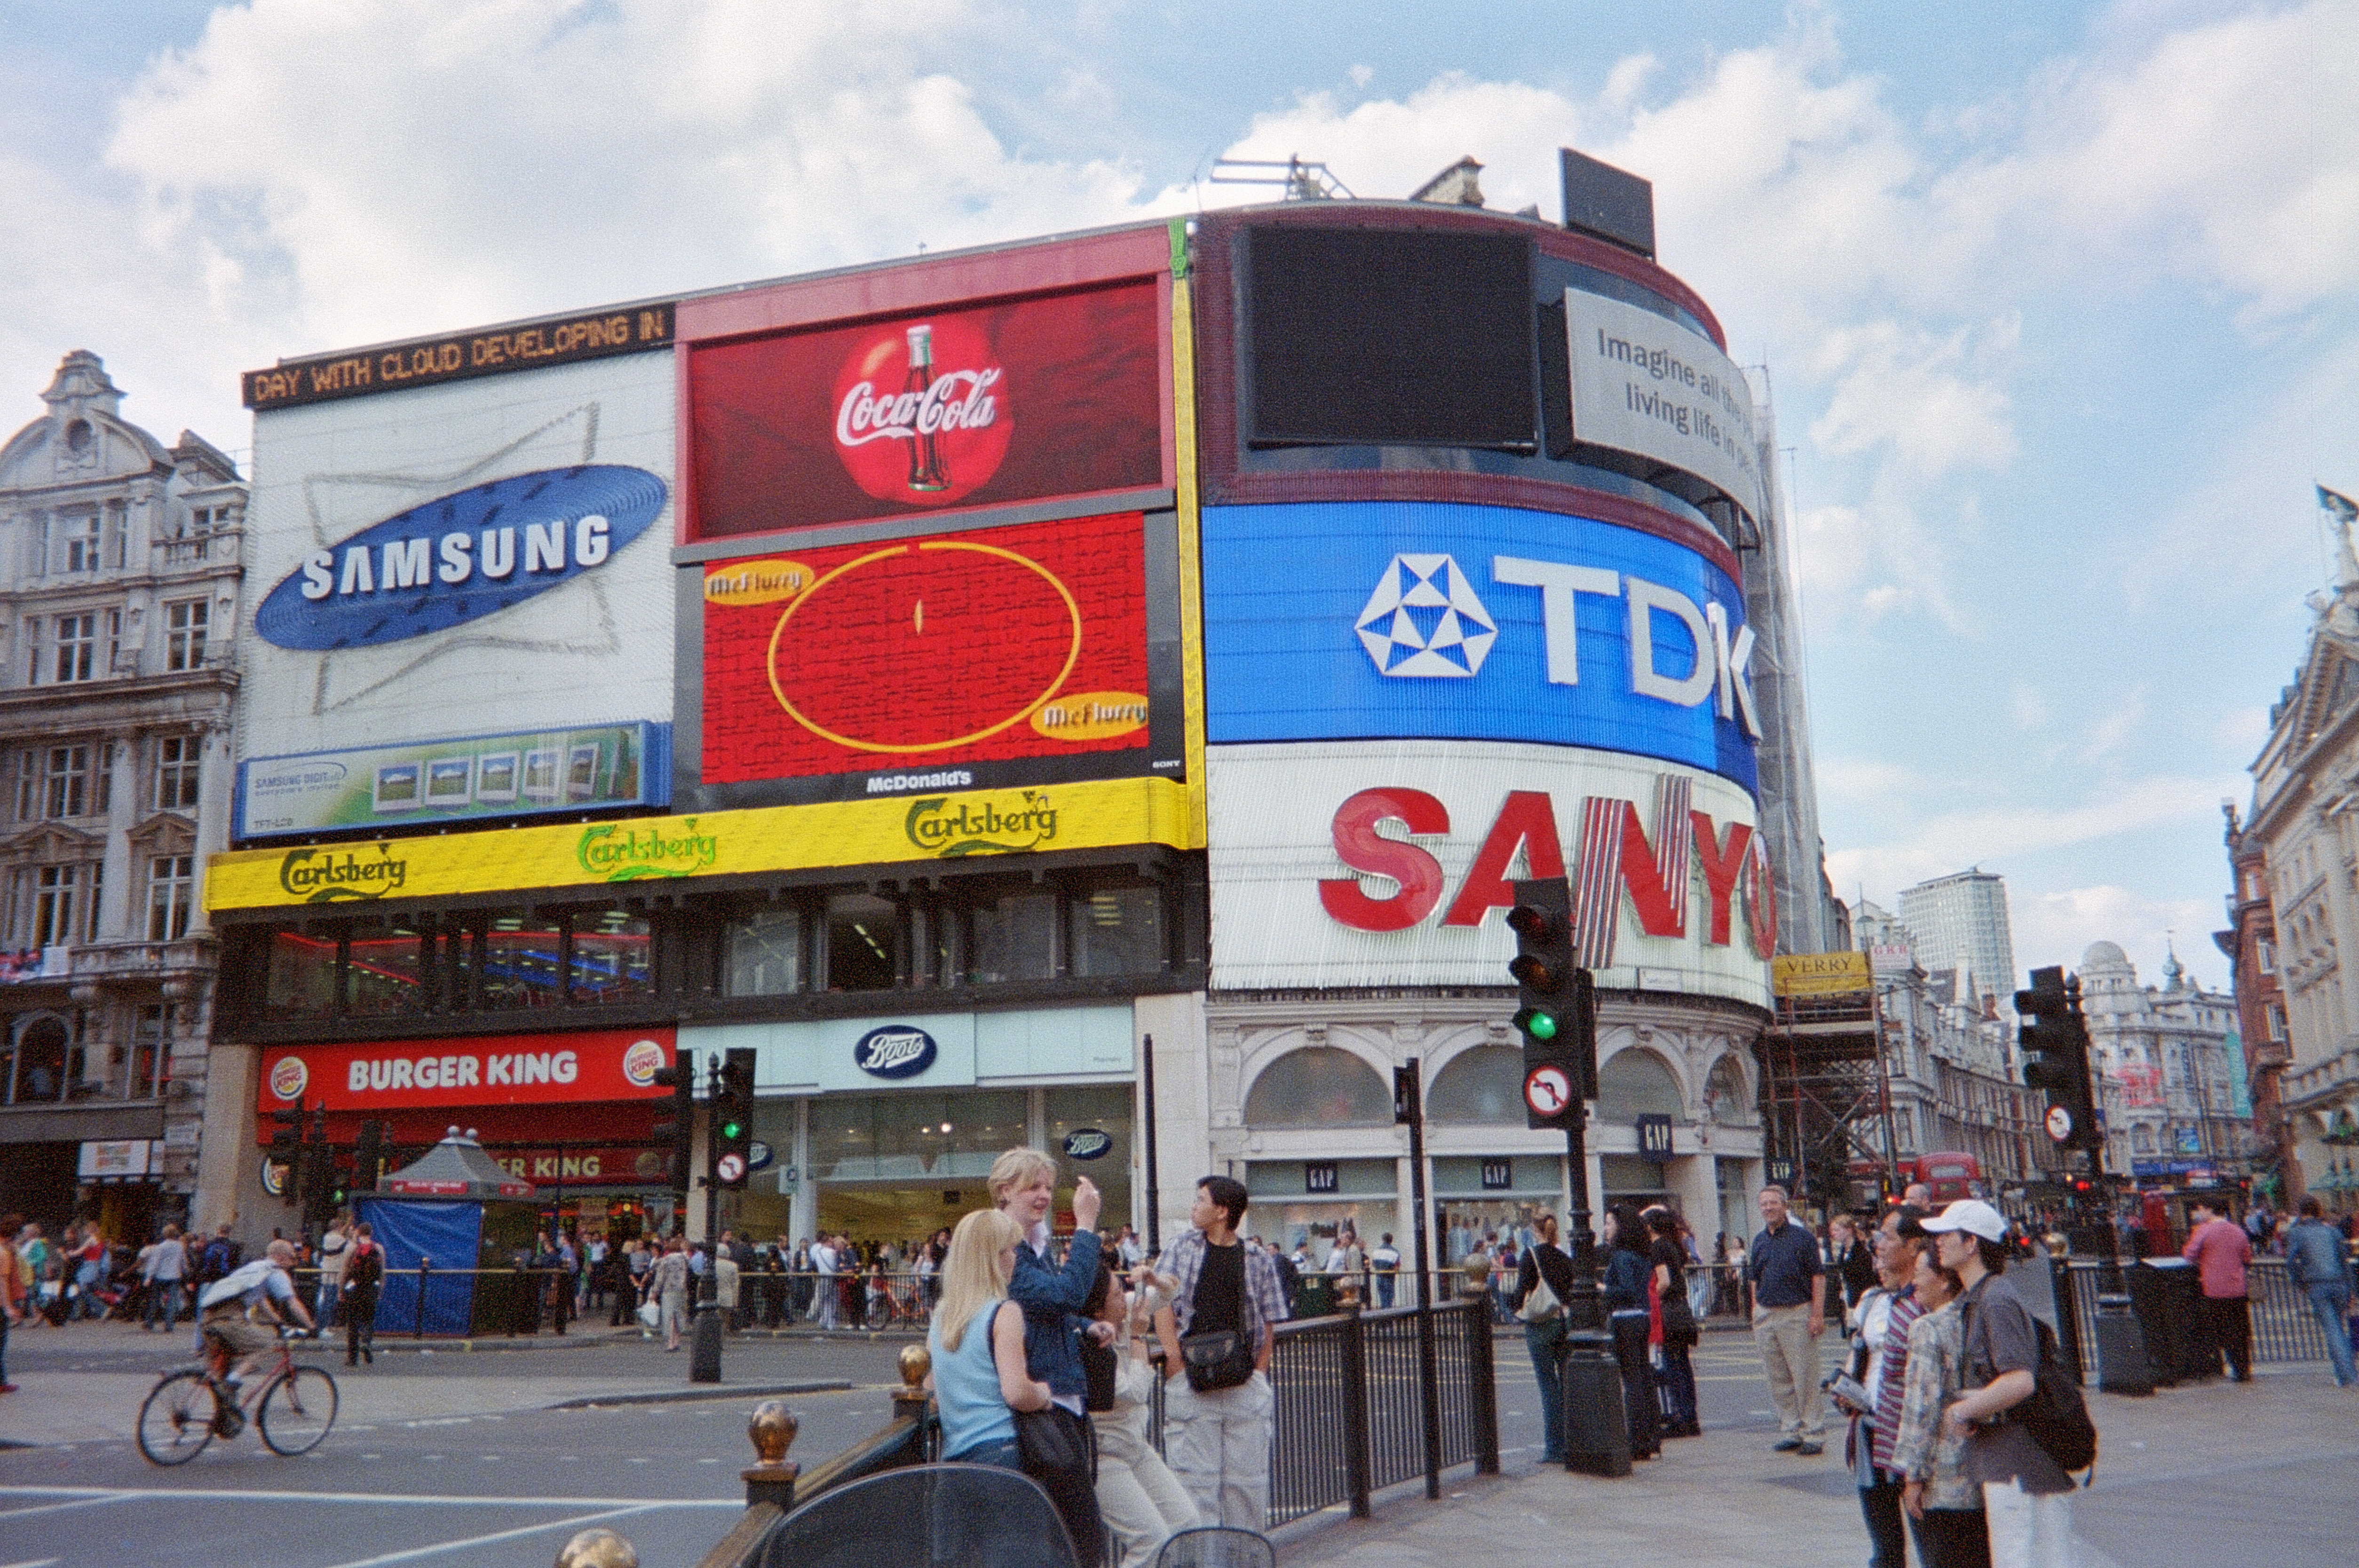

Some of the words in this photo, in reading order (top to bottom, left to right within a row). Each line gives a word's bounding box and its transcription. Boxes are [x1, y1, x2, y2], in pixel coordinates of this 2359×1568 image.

[255, 369, 301, 401] DAY
[311, 357, 372, 392] WITH
[381, 343, 462, 381] CLOUD
[471, 315, 629, 366] DEVELOPING
[638, 309, 664, 340] IN
[1598, 328, 1695, 387] Imagine
[1700, 375, 1719, 402] all
[837, 367, 1000, 446] Coca-Cola
[1626, 382, 1690, 435] living
[1693, 407, 1720, 447] life
[301, 514, 610, 601] SAMSUNG
[1494, 555, 1762, 741] TDK
[866, 770, 972, 793] McDonald's
[1153, 760, 1181, 769] SONY
[905, 796, 1057, 856] Carlsberg
[281, 848, 406, 902] Carlsberg
[578, 823, 717, 882] Carlsberg
[1319, 773, 1777, 969] SANYO
[348, 1055, 480, 1091] BURGER
[486, 1050, 578, 1086] KING
[631, 1056, 658, 1074] KING
[862, 1031, 926, 1070] Boots
[277, 1072, 302, 1088] KING
[1645, 1124, 1668, 1152] GAP
[534, 1156, 601, 1178] KING
[1311, 1168, 1333, 1189] GAP
[1485, 1165, 1507, 1184] GAP
